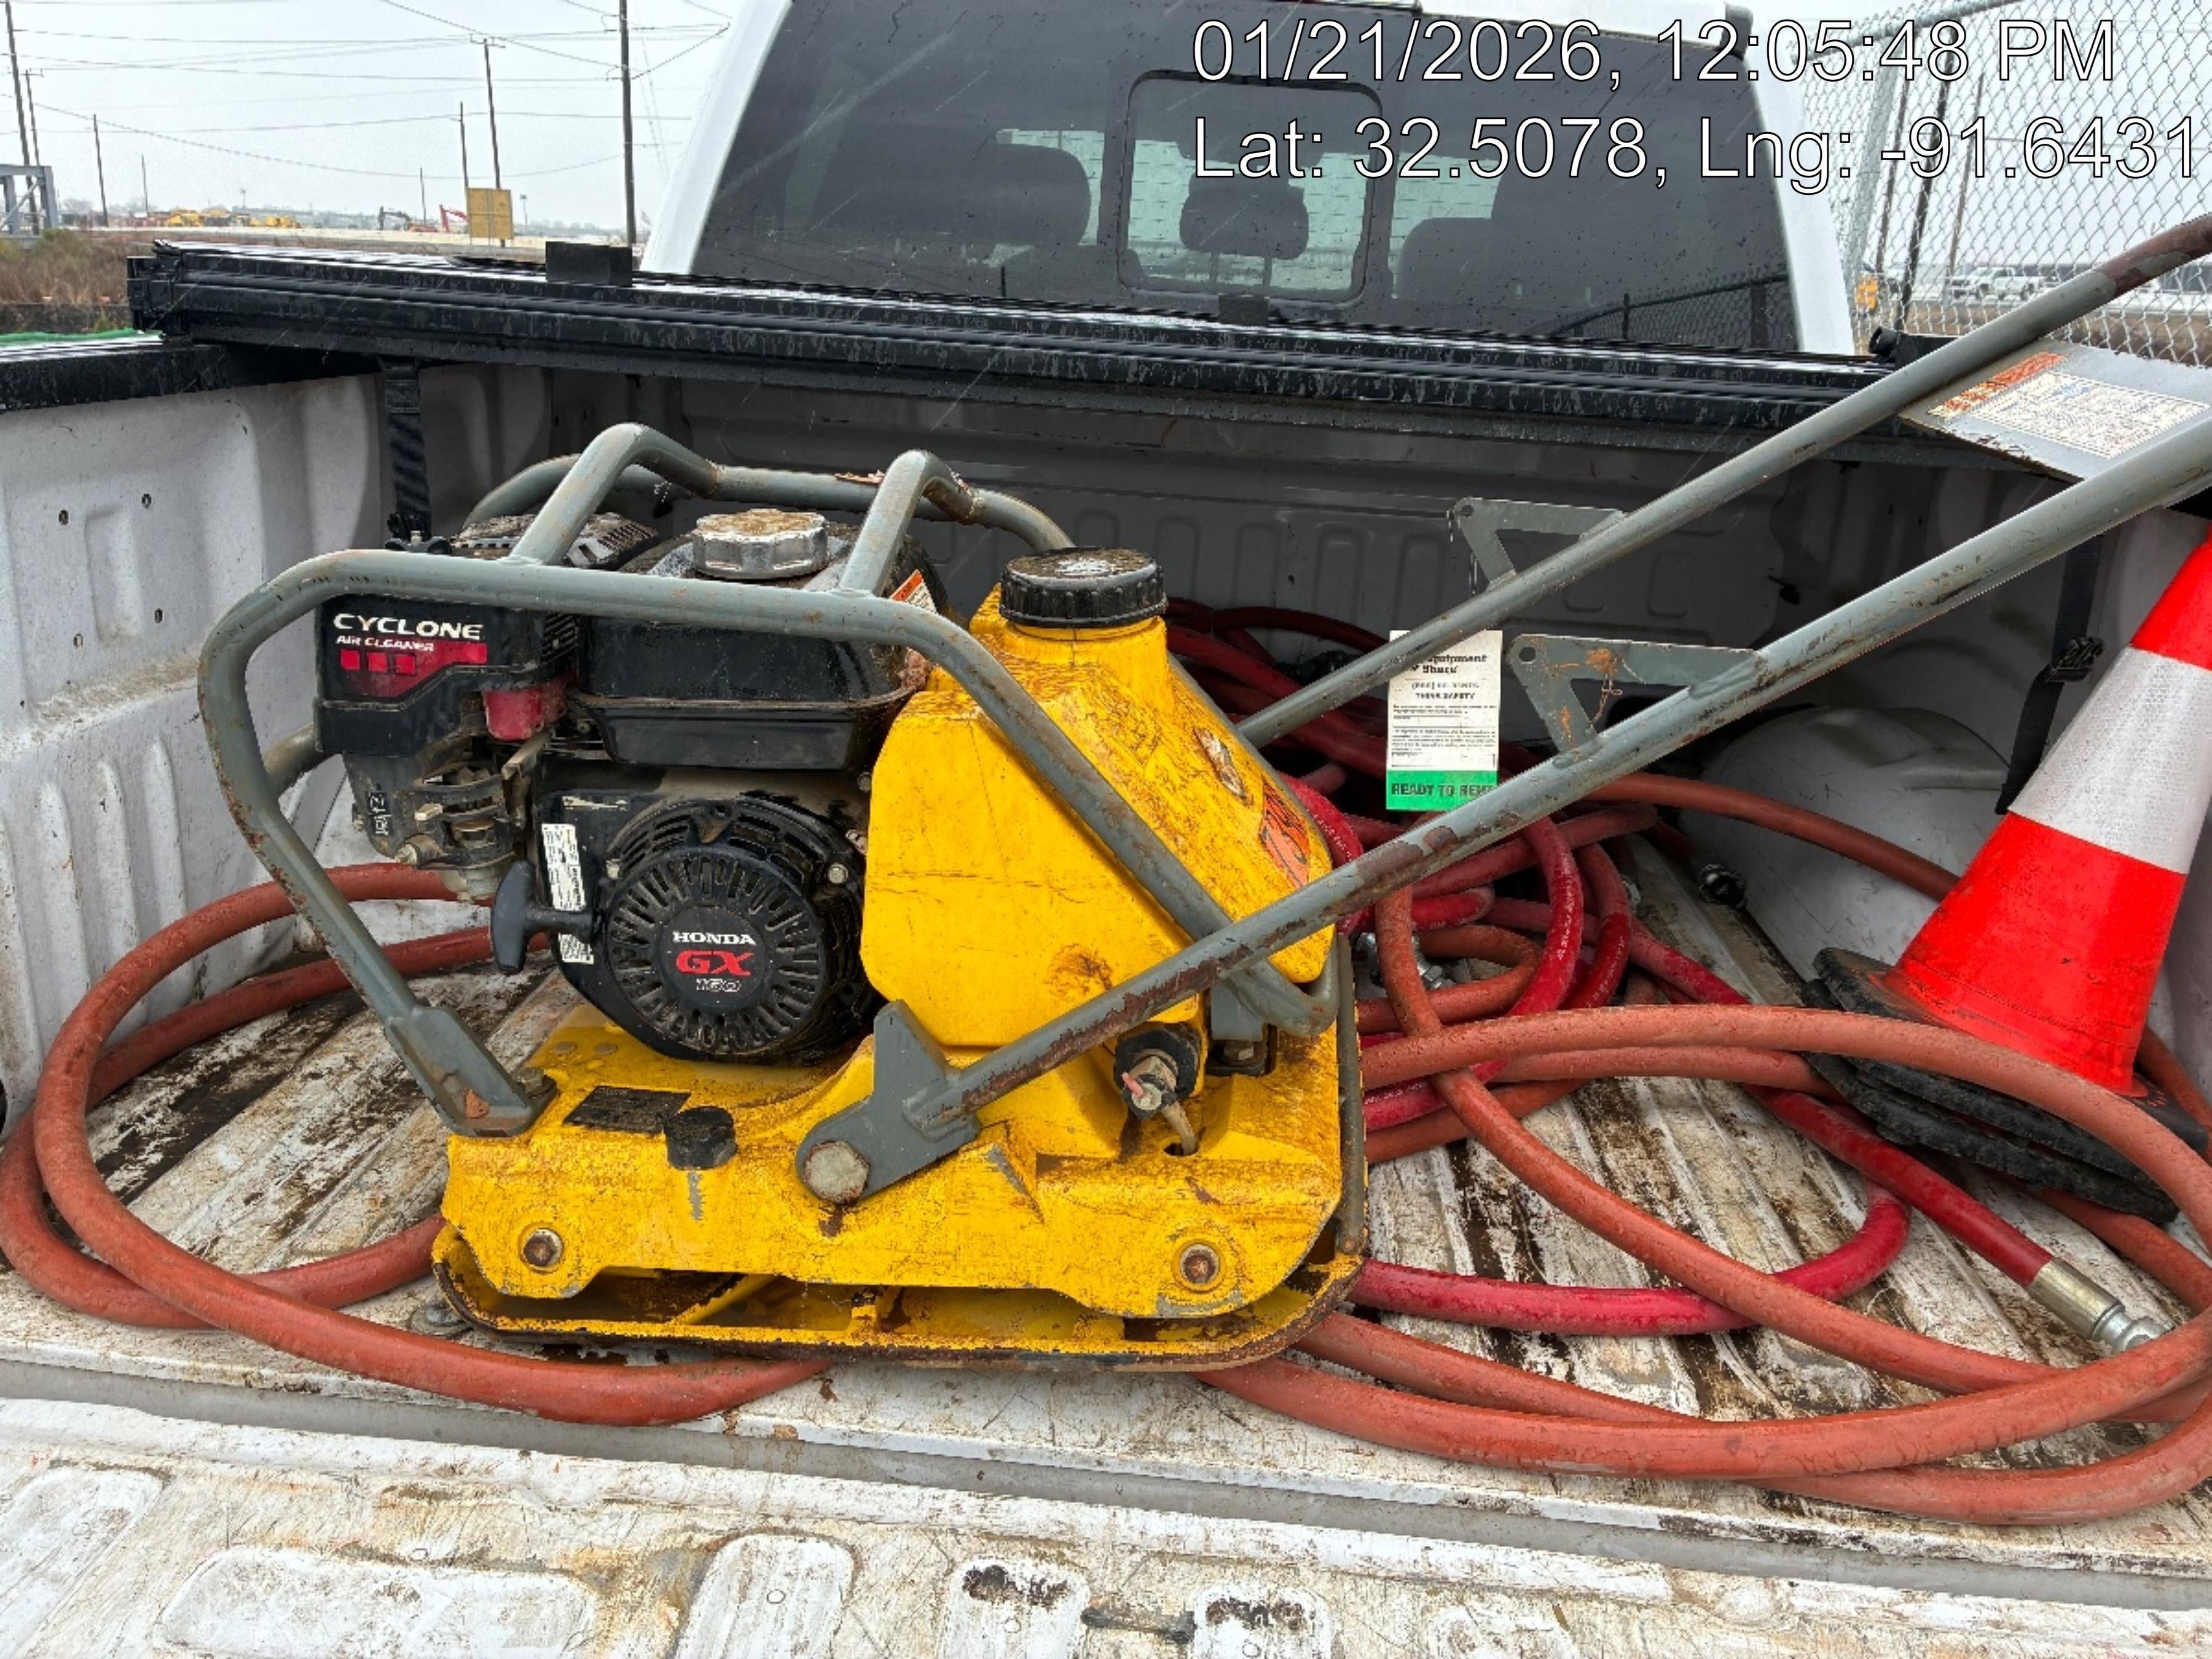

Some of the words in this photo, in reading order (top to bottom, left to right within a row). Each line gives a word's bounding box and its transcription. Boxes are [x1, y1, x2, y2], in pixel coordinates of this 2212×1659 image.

[334, 613, 484, 640] CYCLONE
[336, 635, 359, 646] AIR
[365, 638, 434, 651] CLEANER
[1391, 783, 1434, 795] READY
[1438, 785, 1457, 796] TO
[673, 931, 757, 945] HONDA
[676, 949, 754, 977] GX
